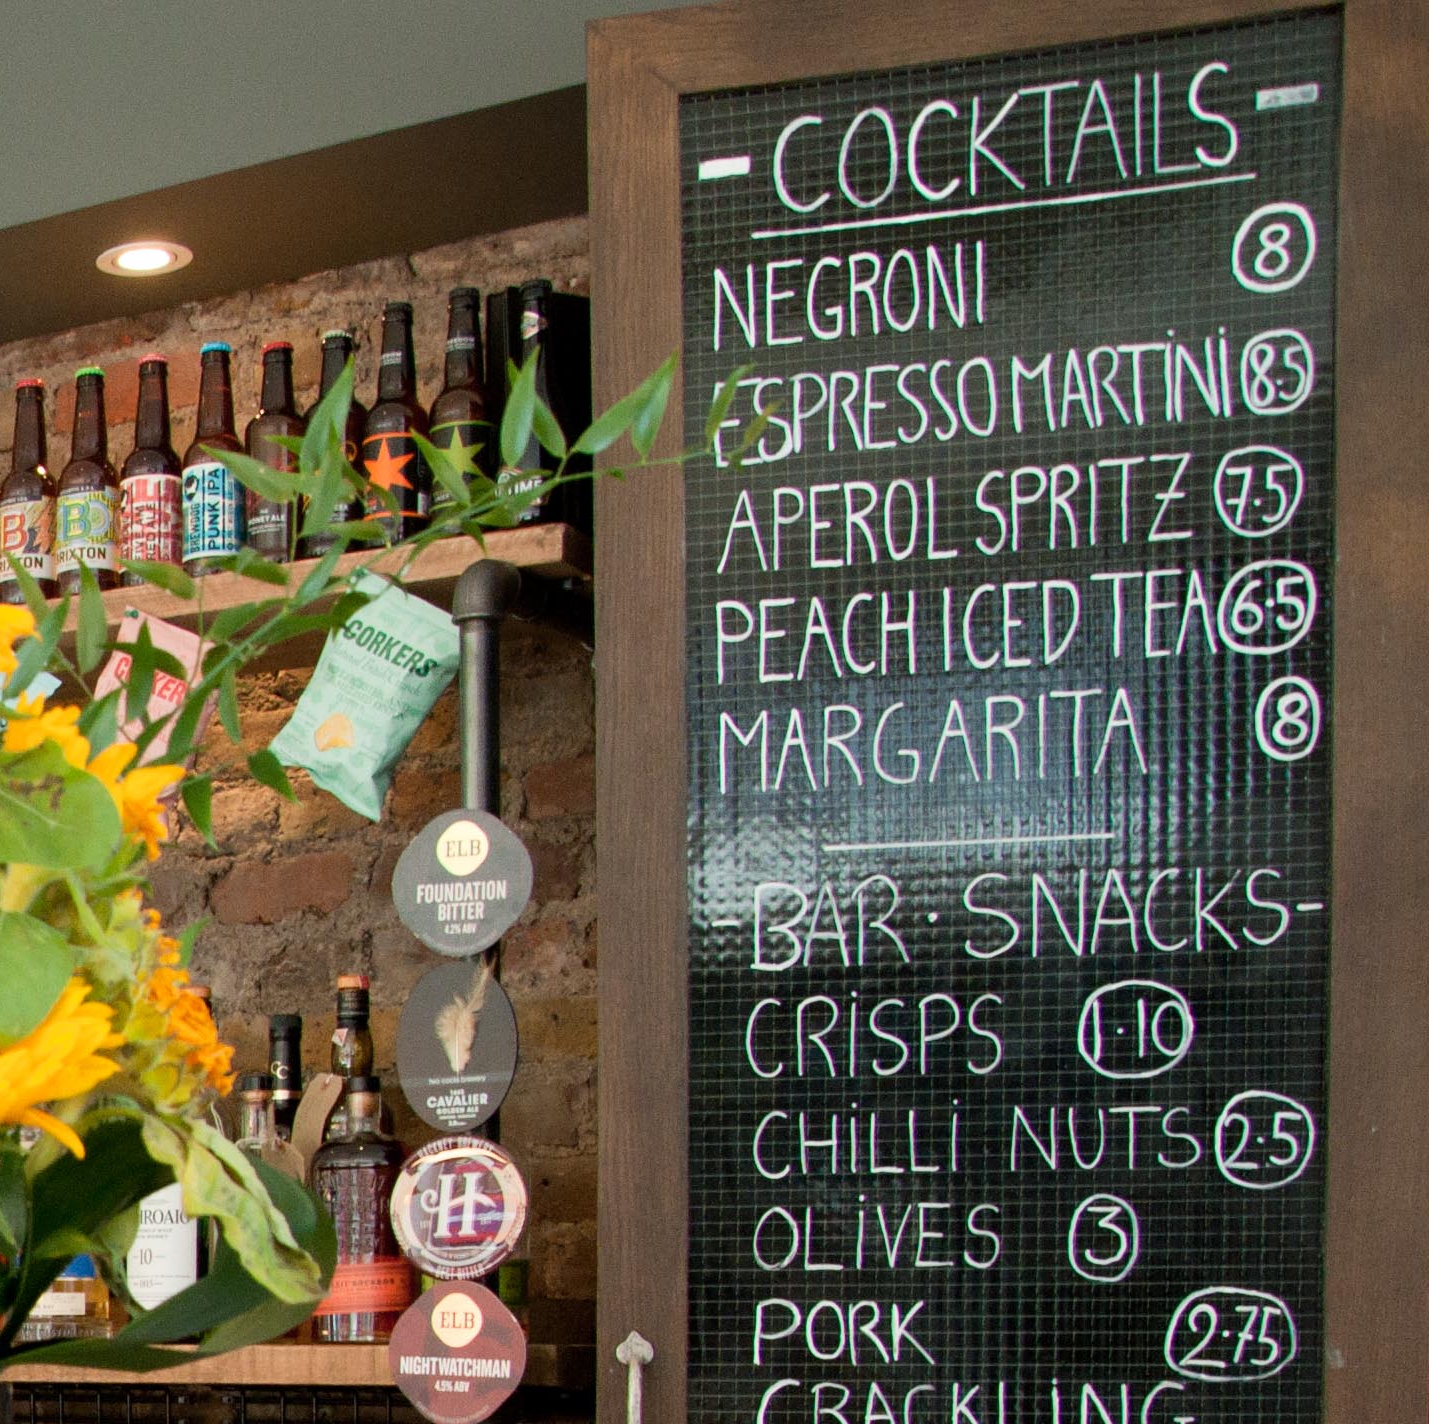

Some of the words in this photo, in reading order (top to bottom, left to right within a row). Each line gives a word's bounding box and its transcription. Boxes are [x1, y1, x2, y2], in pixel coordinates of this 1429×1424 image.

[773, 63, 1239, 213] COCKTAILS
[714, 241, 985, 351] NEGRONI
[715, 357, 998, 468] ESPRESSO
[208, 467, 221, 497] IPA
[207, 502, 221, 551] PUNK
[718, 479, 957, 573] APEROL
[976, 453, 1193, 557] SPRITZ
[717, 591, 915, 685] PEACH
[943, 581, 1079, 671] ICED
[1091, 570, 1218, 659] TEA
[718, 689, 1147, 793] MARGARITA
[445, 838, 482, 858] ELB
[416, 880, 508, 904] FOUNDATION
[437, 901, 485, 922] BITTER
[426, 1093, 488, 1108] CAVALIER
[1011, 1106, 1202, 1172] NUTS
[440, 1311, 475, 1329] ELB
[754, 1299, 934, 1365] PORK
[400, 1356, 511, 1379] NIGHTWATCHMAN
